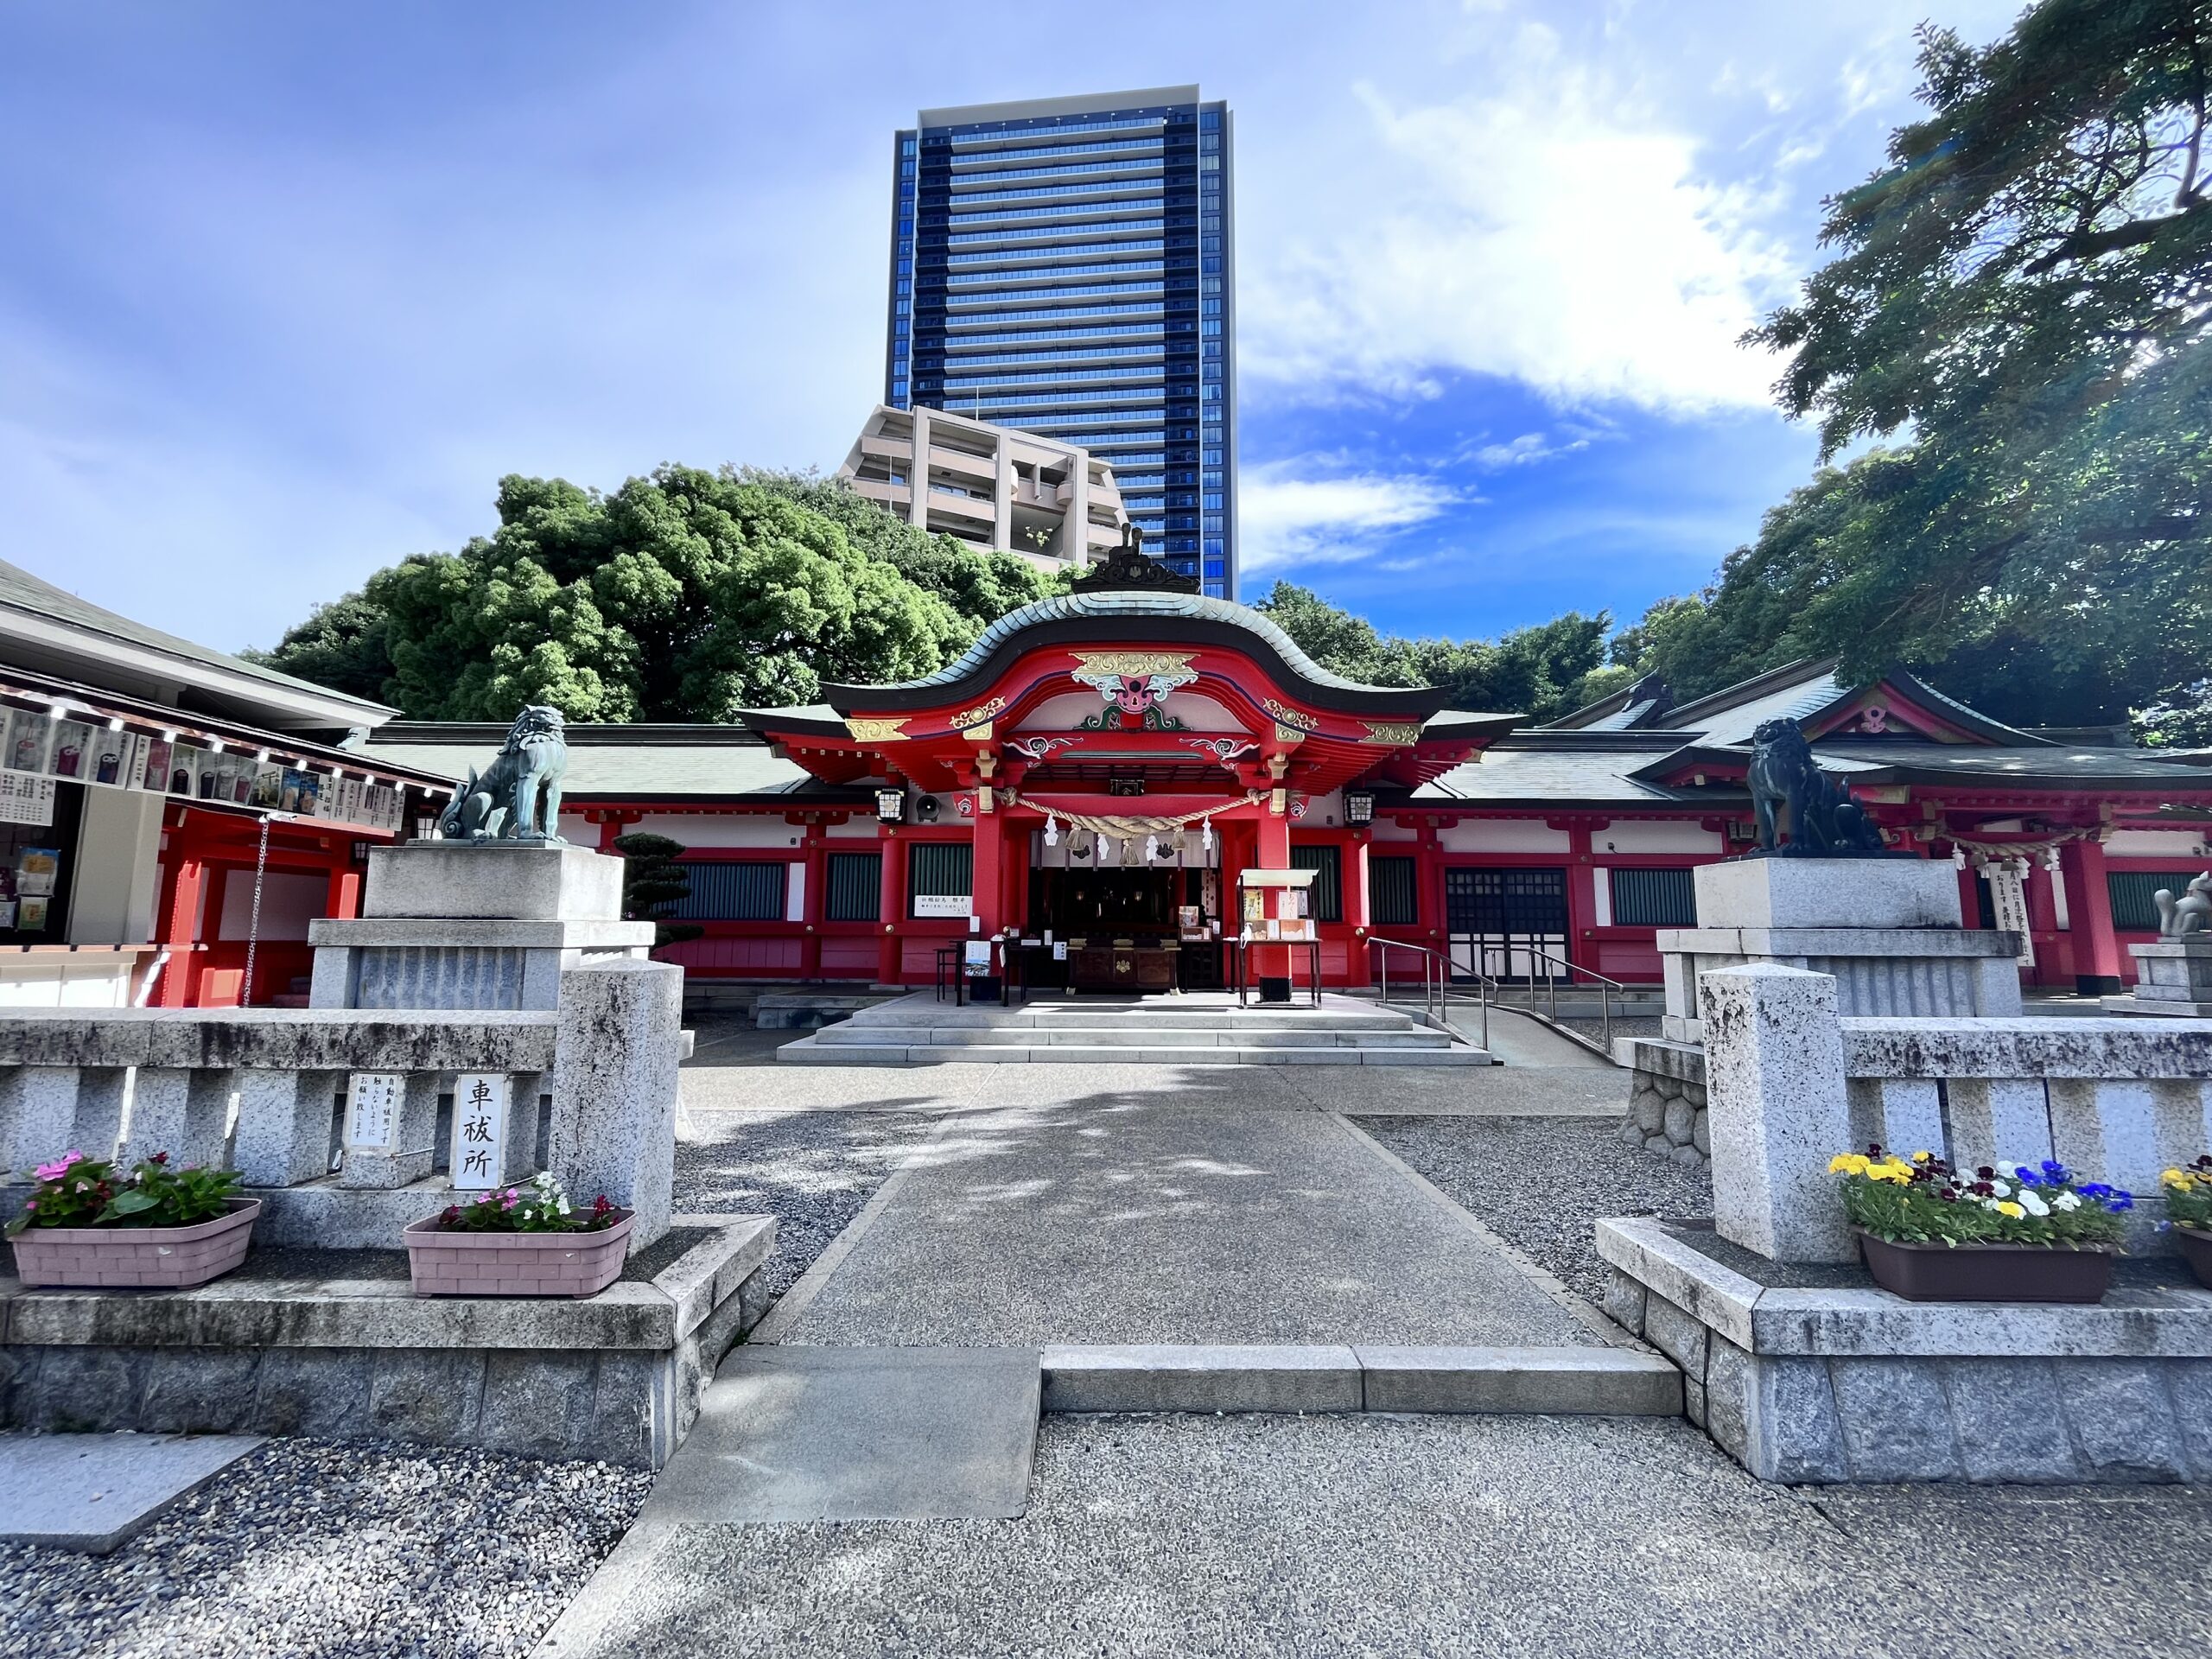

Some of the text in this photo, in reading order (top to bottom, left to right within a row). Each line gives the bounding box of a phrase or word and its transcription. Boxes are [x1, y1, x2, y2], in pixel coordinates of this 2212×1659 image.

[353, 1076, 368, 1139] お願い致します
[368, 1076, 382, 1136] 触らないように
[463, 1078, 494, 1179] 車祓所
